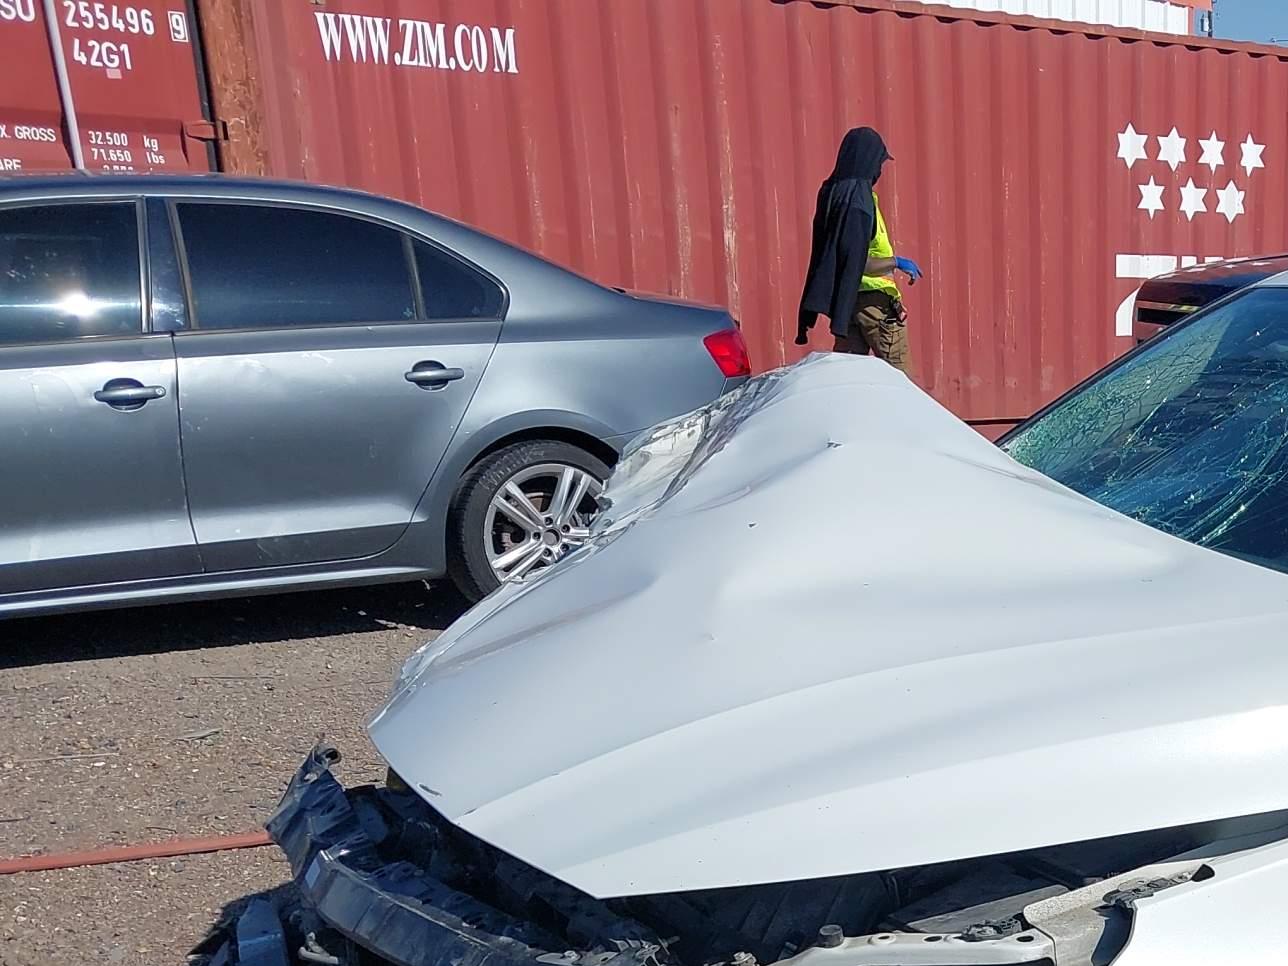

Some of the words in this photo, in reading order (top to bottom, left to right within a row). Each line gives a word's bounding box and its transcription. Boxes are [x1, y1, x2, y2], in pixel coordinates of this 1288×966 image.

[63, 0, 155, 35] 255496
[170, 12, 187, 41] 9
[73, 38, 132, 70] 42G1
[15, 125, 57, 142] GROSS
[88, 130, 128, 147] 32.500
[143, 135, 159, 151] kg
[91, 148, 132, 163] 71.650
[146, 151, 166, 165] lbs
